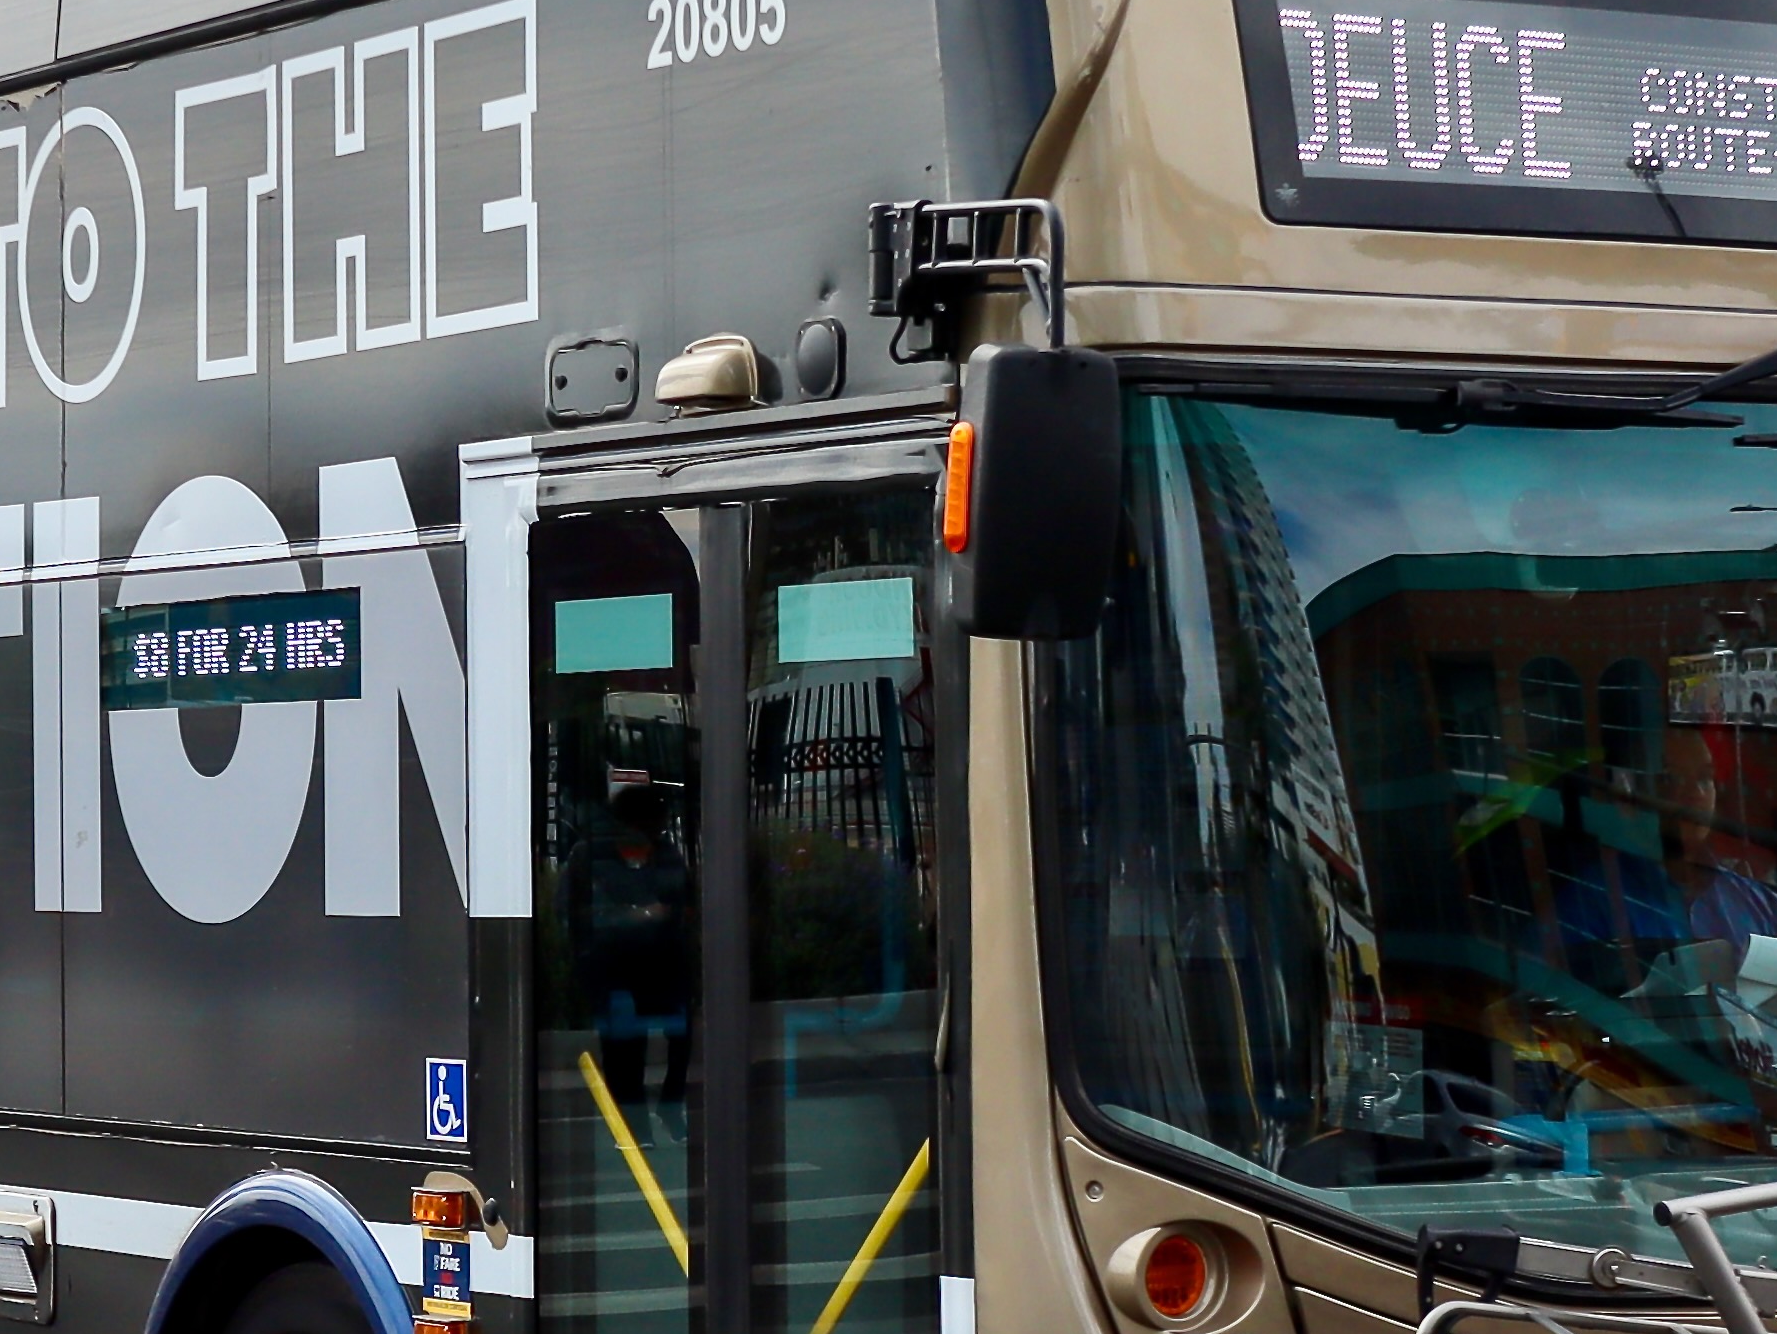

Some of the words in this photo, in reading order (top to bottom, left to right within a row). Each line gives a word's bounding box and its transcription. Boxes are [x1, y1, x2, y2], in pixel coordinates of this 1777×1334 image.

[176, 627, 230, 676] FOR
[238, 624, 277, 672] 24
[285, 619, 345, 670] HRS
